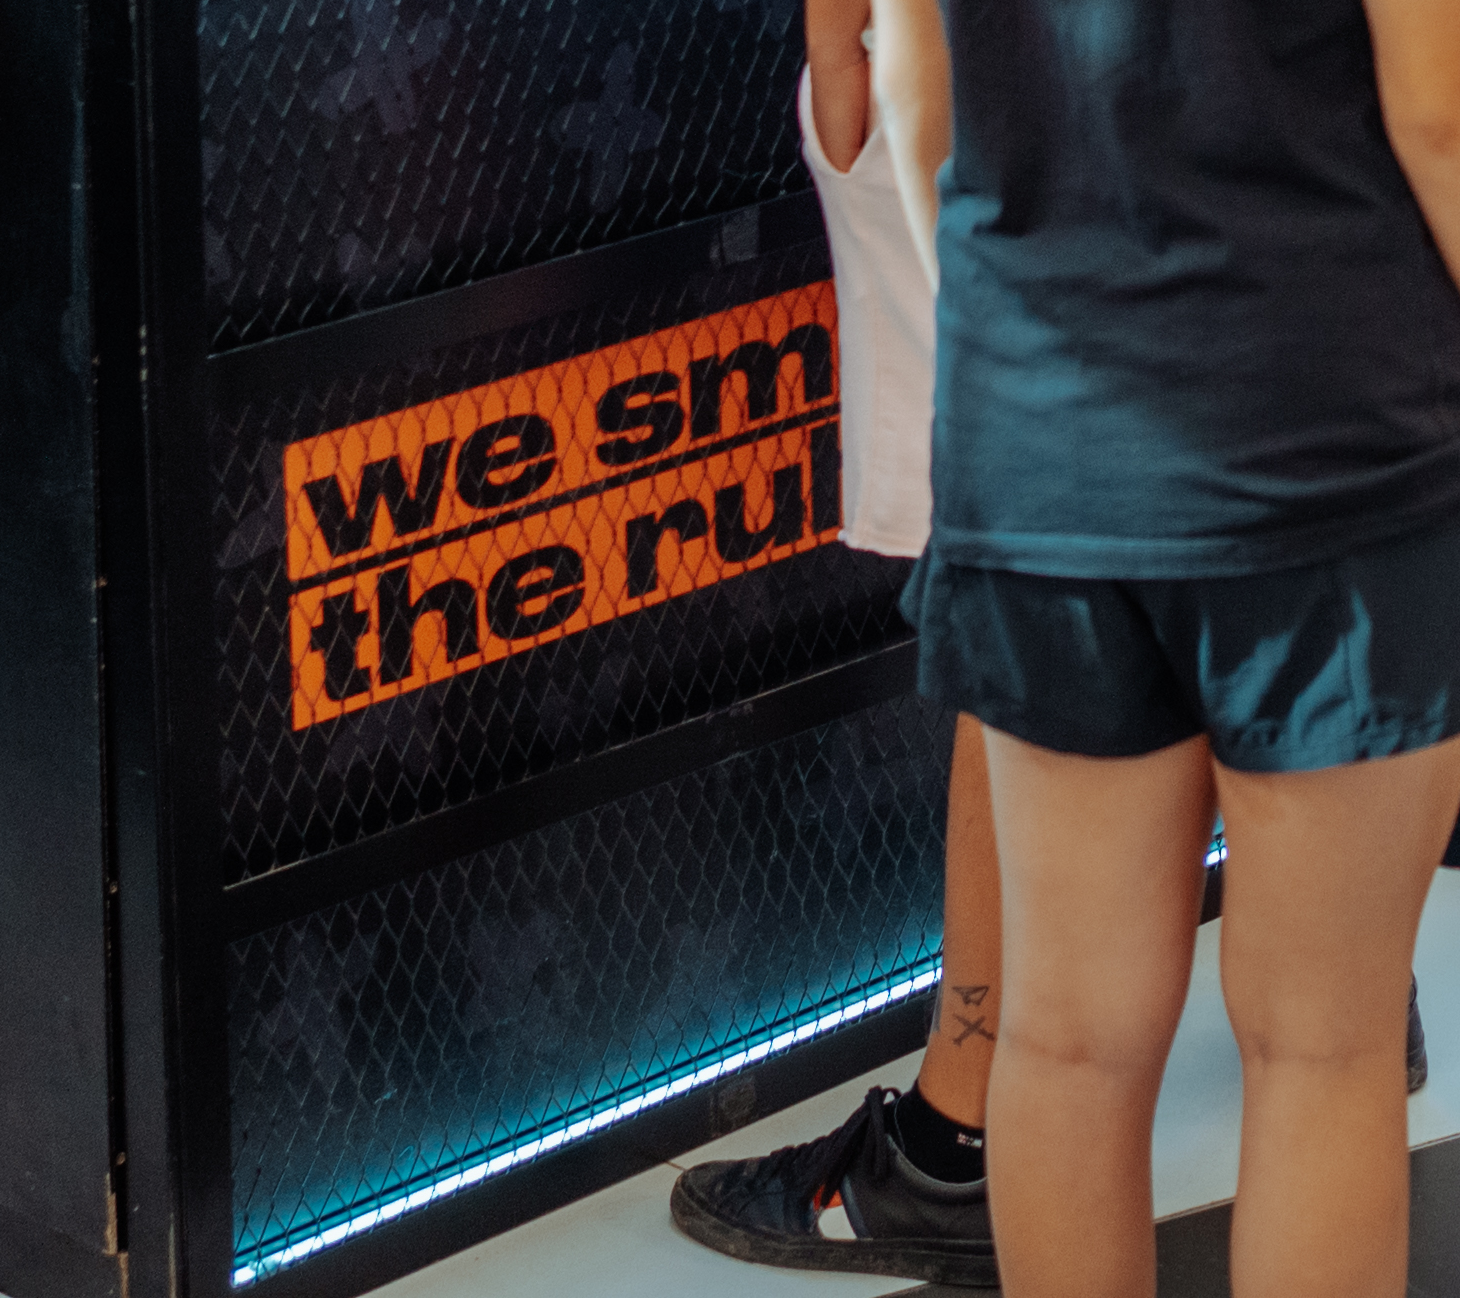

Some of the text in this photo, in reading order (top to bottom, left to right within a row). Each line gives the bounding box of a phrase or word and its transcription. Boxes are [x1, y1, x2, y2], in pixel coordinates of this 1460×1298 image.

[302, 322, 833, 560] we sm
[308, 543, 586, 703] the
